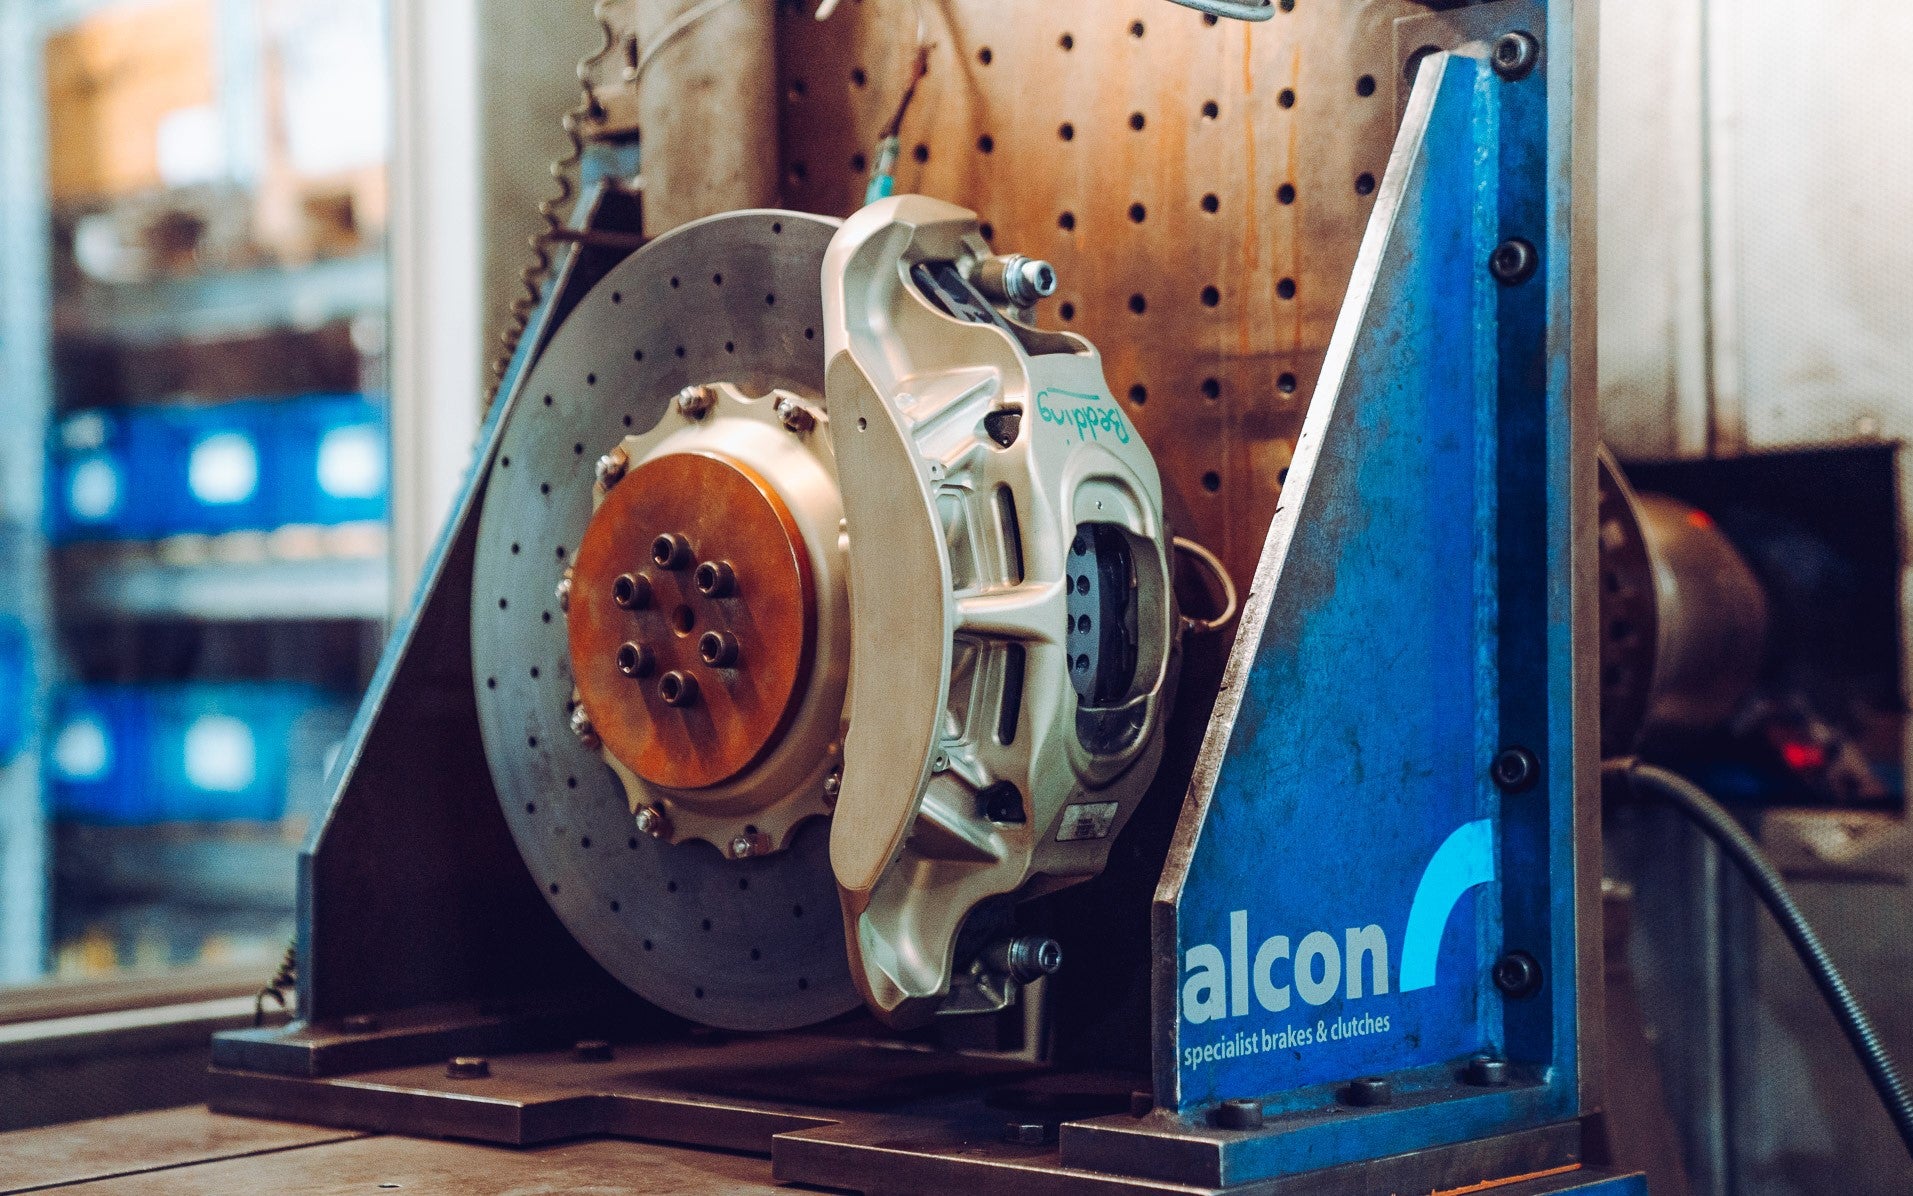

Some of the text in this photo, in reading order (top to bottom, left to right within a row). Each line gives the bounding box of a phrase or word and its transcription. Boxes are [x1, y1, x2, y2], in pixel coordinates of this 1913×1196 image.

[1036, 390, 1130, 446] Bedding
[1182, 910, 1389, 1024] alcon
[1184, 1012, 1391, 1070] specialist brakes & clutches
